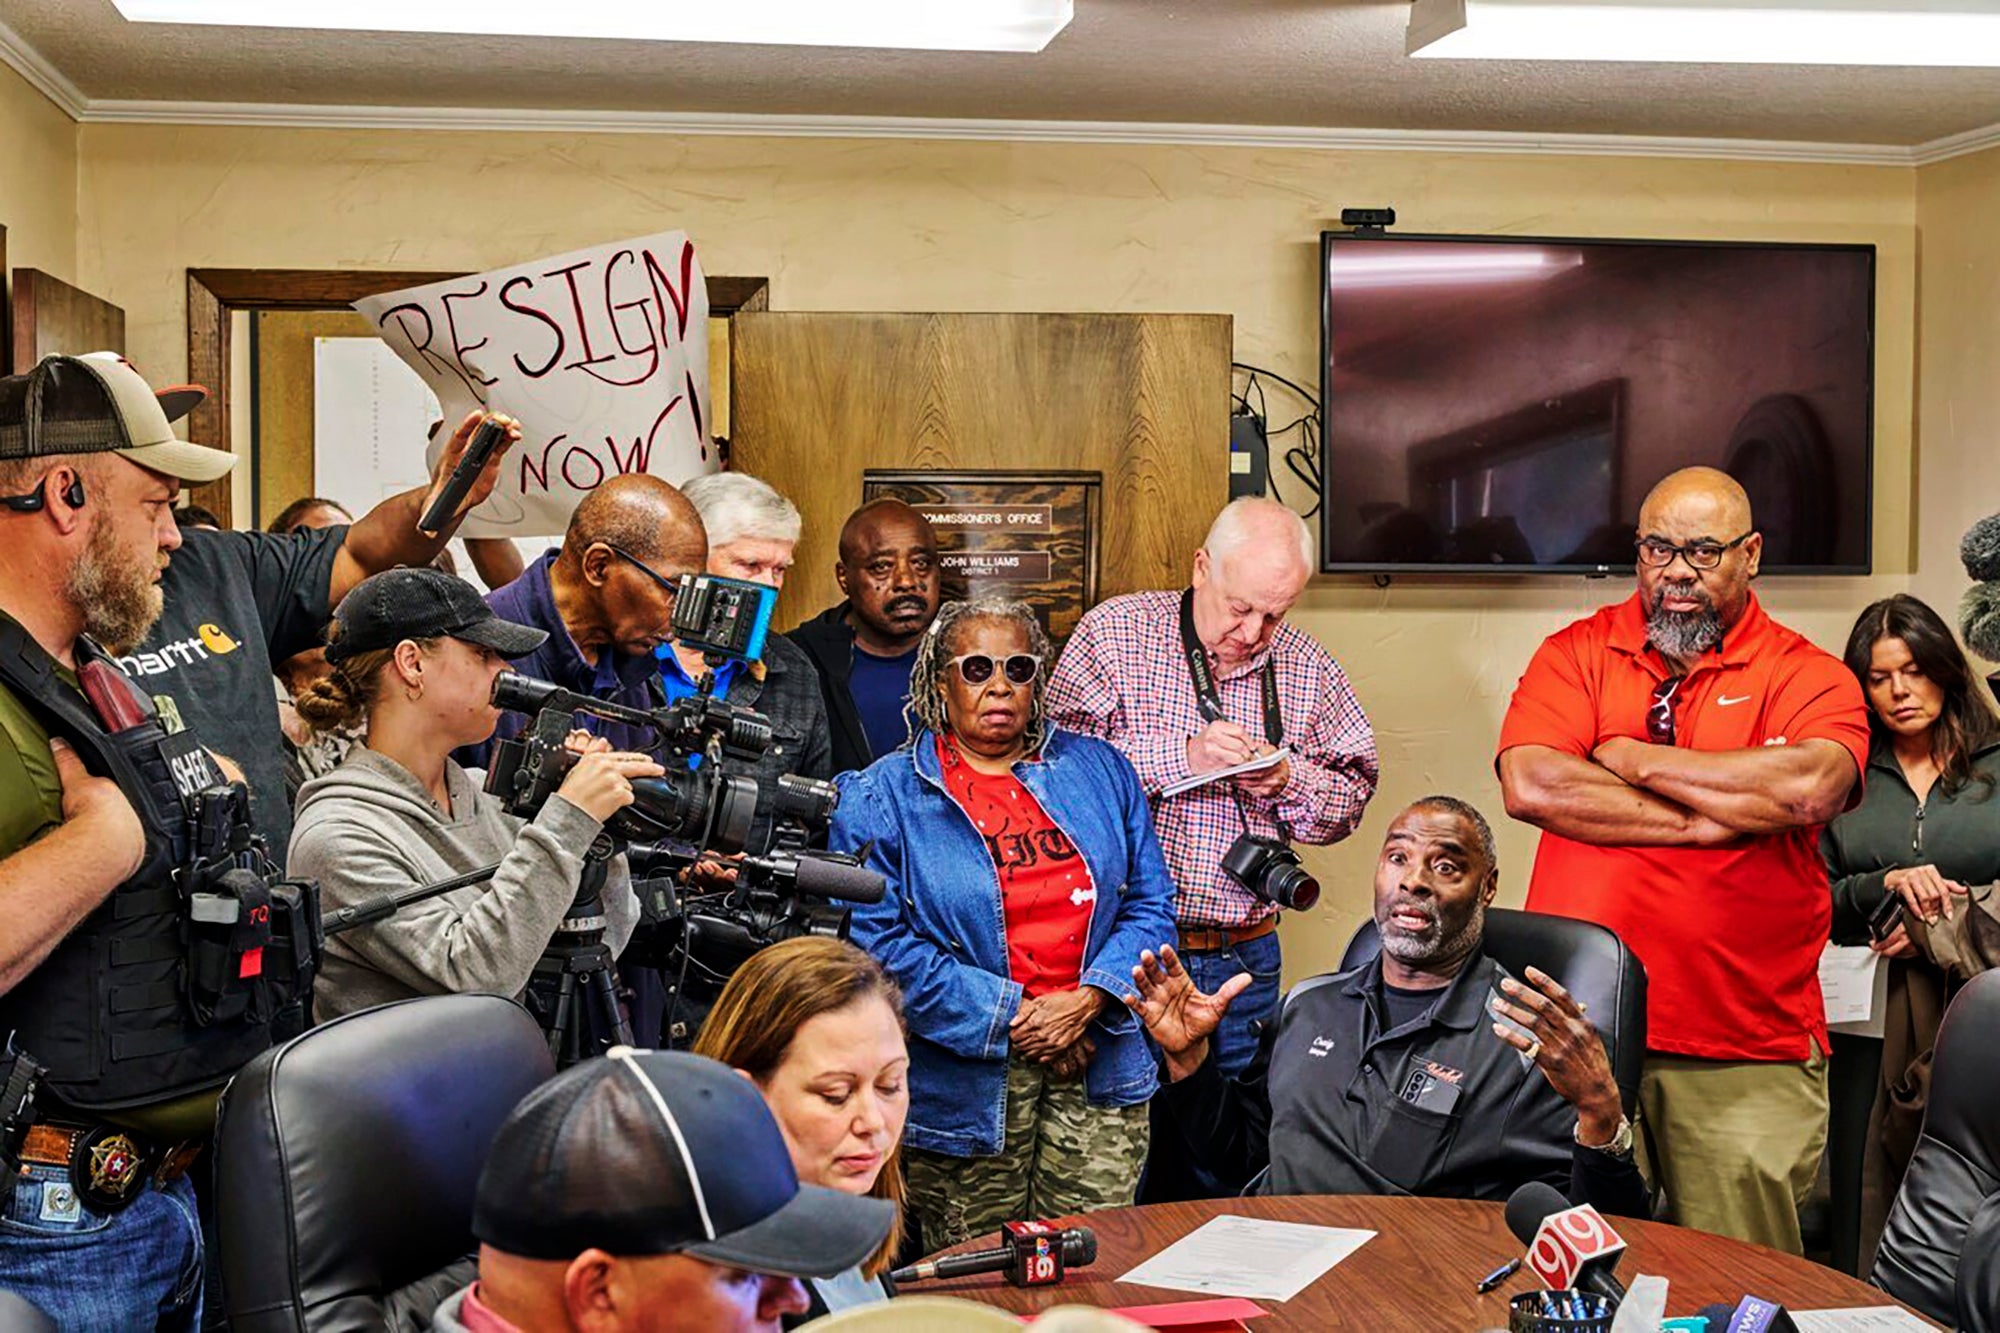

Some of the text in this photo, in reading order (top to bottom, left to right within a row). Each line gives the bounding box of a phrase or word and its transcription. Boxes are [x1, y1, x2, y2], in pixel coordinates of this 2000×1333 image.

[379, 239, 694, 405] RESIGN
[1007, 513, 1043, 524] OFFICE
[940, 557, 1019, 567] JOHN WILLIAMS
[1191, 648, 1208, 690] Canon
